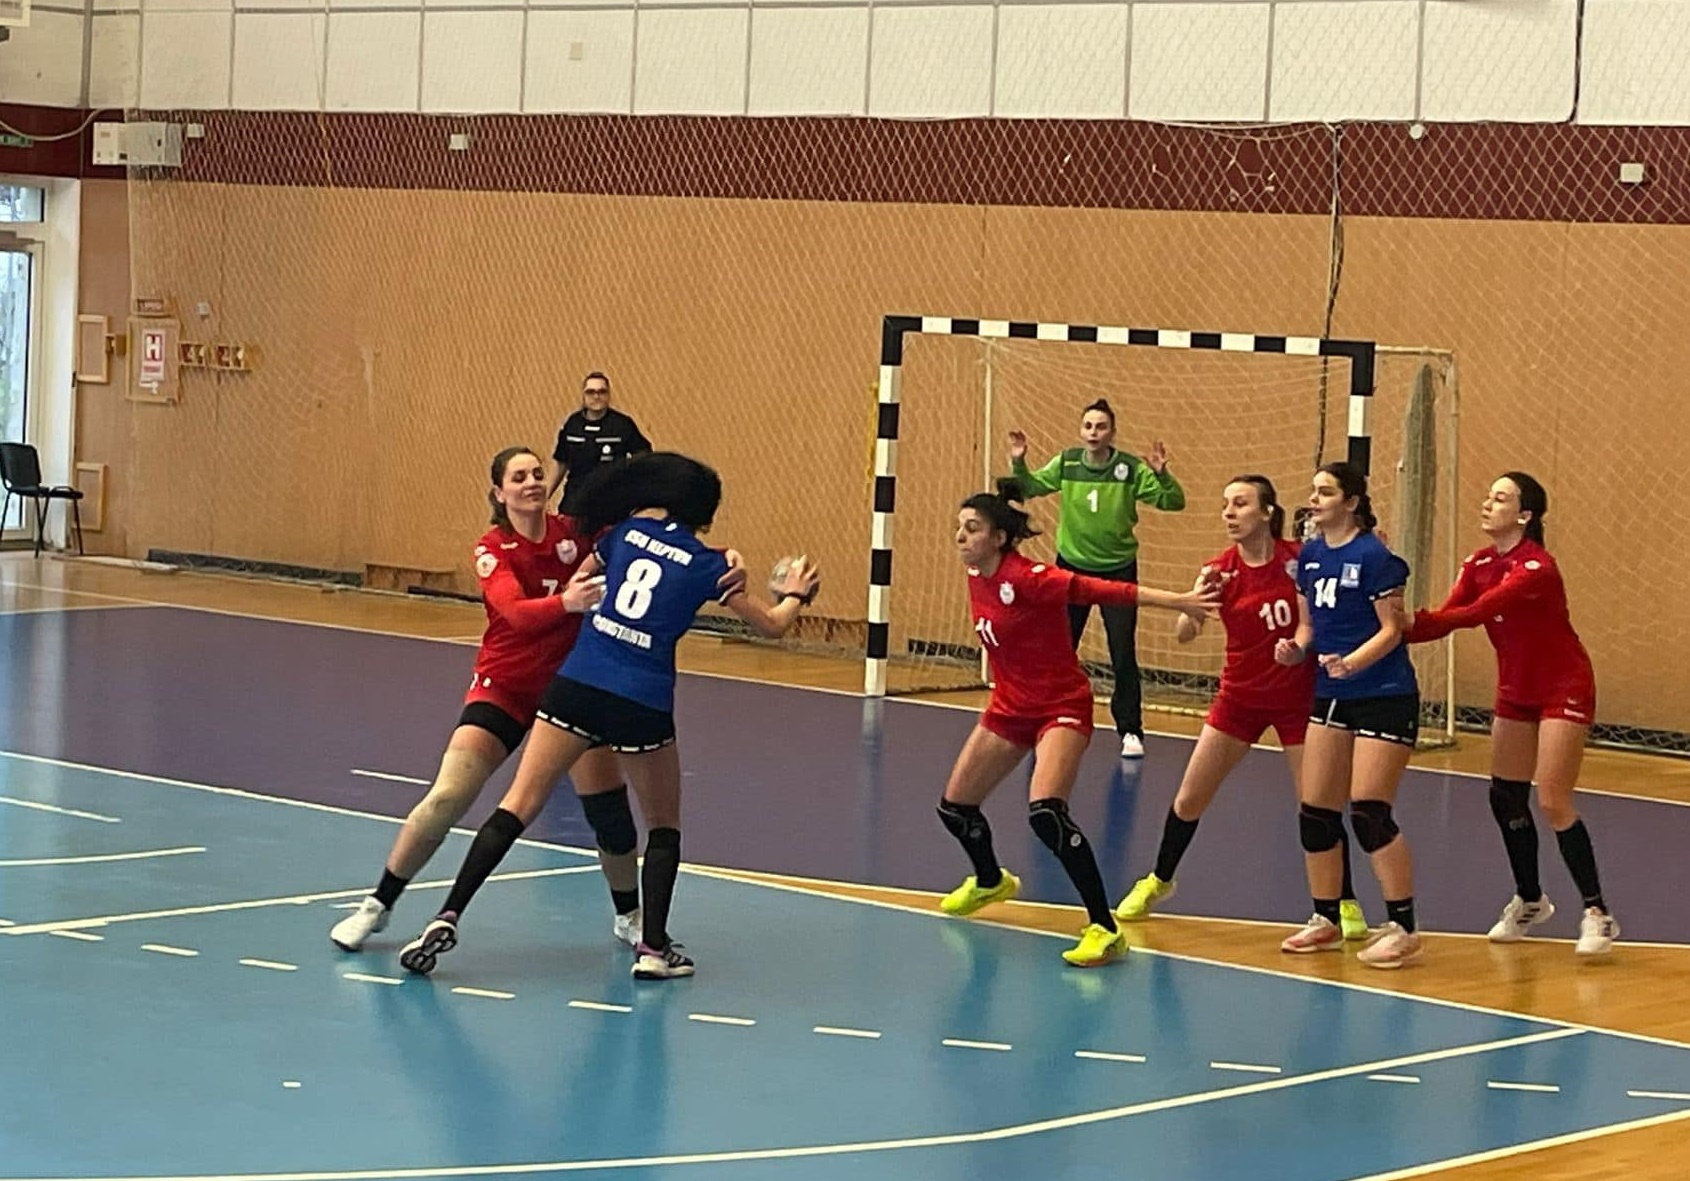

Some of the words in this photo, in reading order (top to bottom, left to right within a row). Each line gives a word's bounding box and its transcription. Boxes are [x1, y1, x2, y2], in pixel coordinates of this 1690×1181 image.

[146, 335, 160, 360] H
[1086, 489, 1099, 512] 1
[615, 558, 662, 620] 8
[1314, 577, 1338, 609] 14
[1259, 599, 1292, 631] 10
[975, 616, 999, 647] 11
